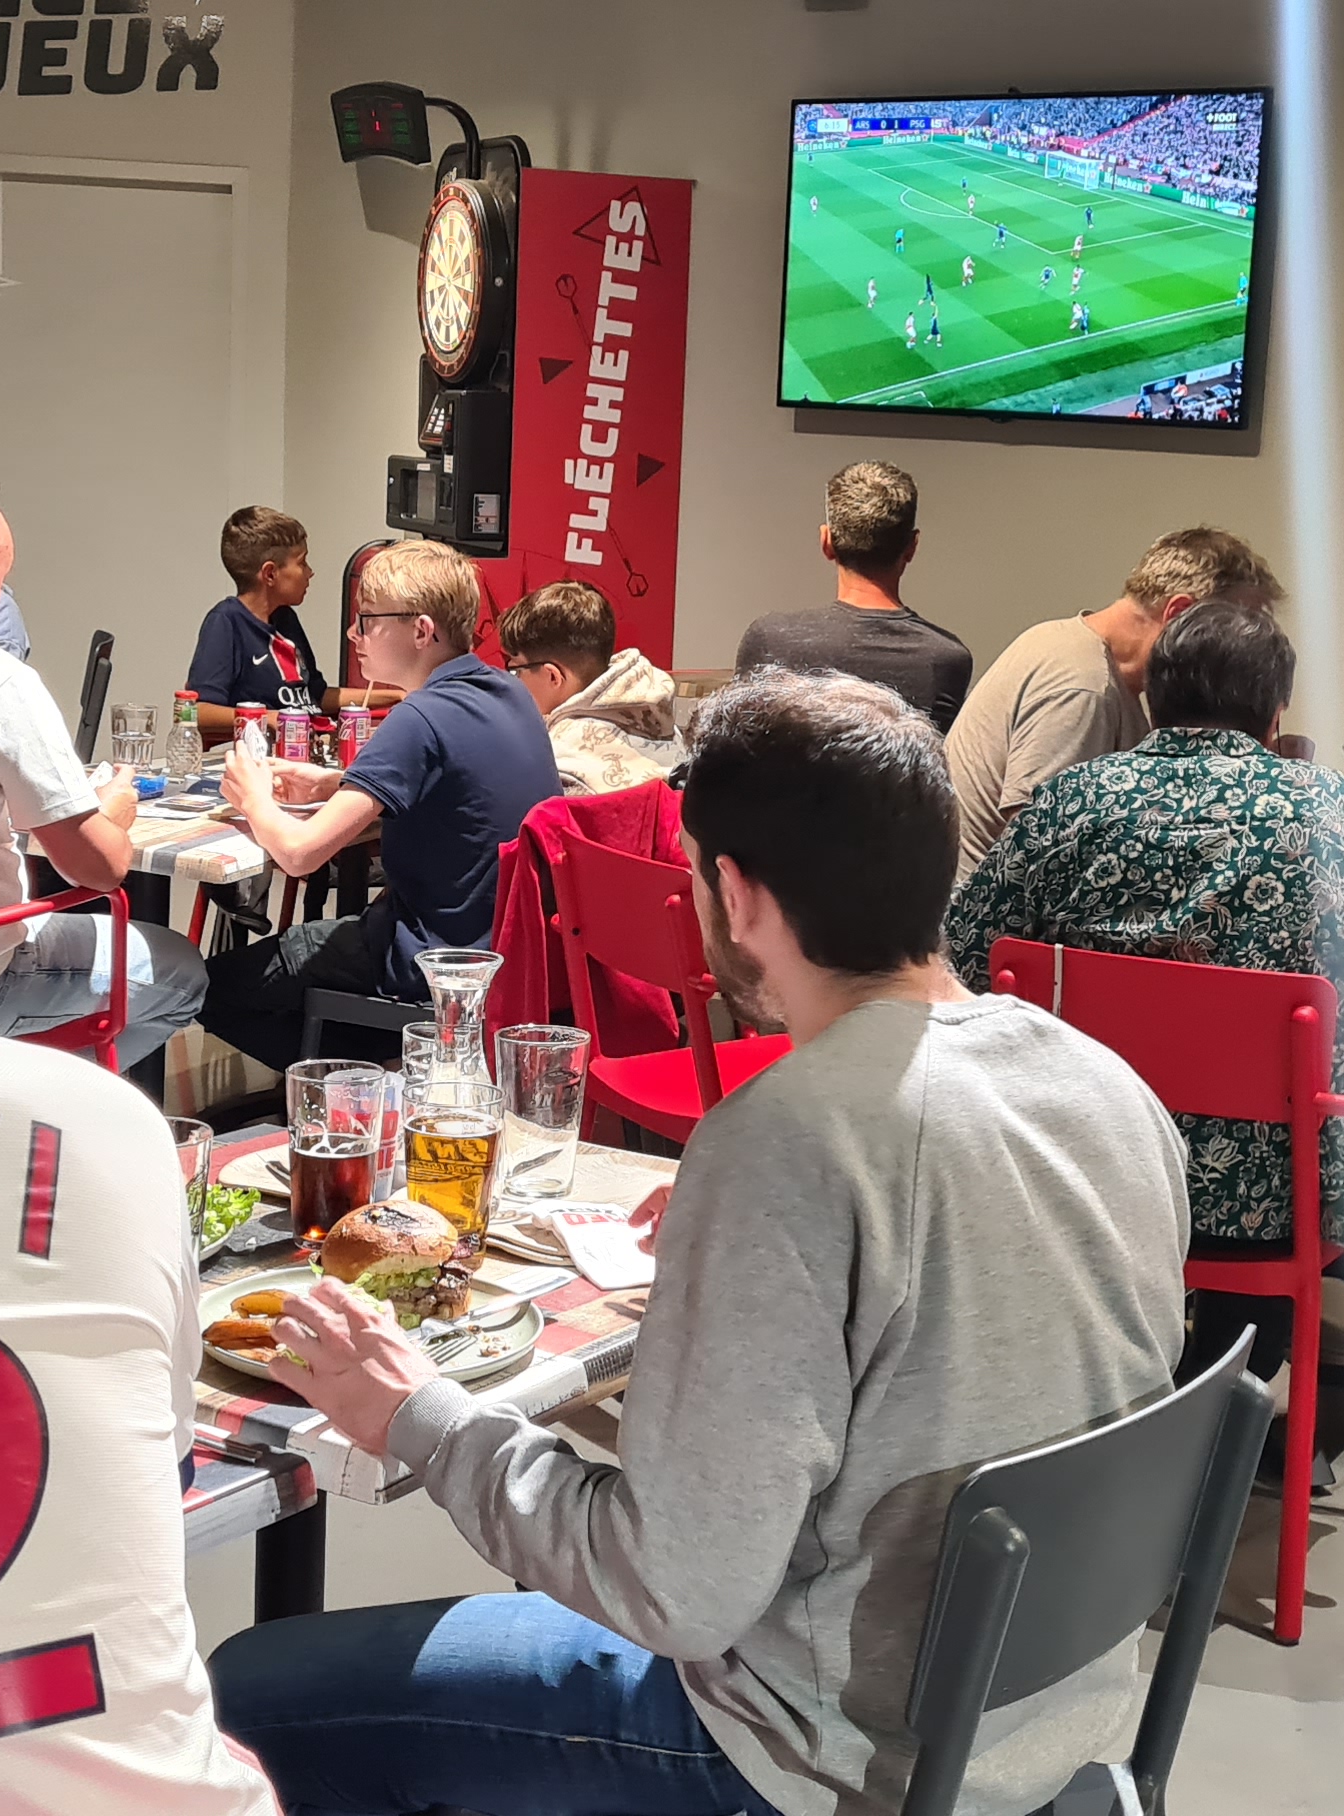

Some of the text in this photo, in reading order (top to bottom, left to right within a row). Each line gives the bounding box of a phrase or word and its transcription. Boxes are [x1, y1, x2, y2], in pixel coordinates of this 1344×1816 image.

[855, 119, 870, 129] ARS
[881, 119, 886, 129] 0
[910, 118, 925, 128] PSG
[797, 139, 839, 151] Heineken
[882, 133, 921, 145] Heineken
[1104, 171, 1143, 192] Heineken
[564, 200, 648, 565] FLÉCHETTES
